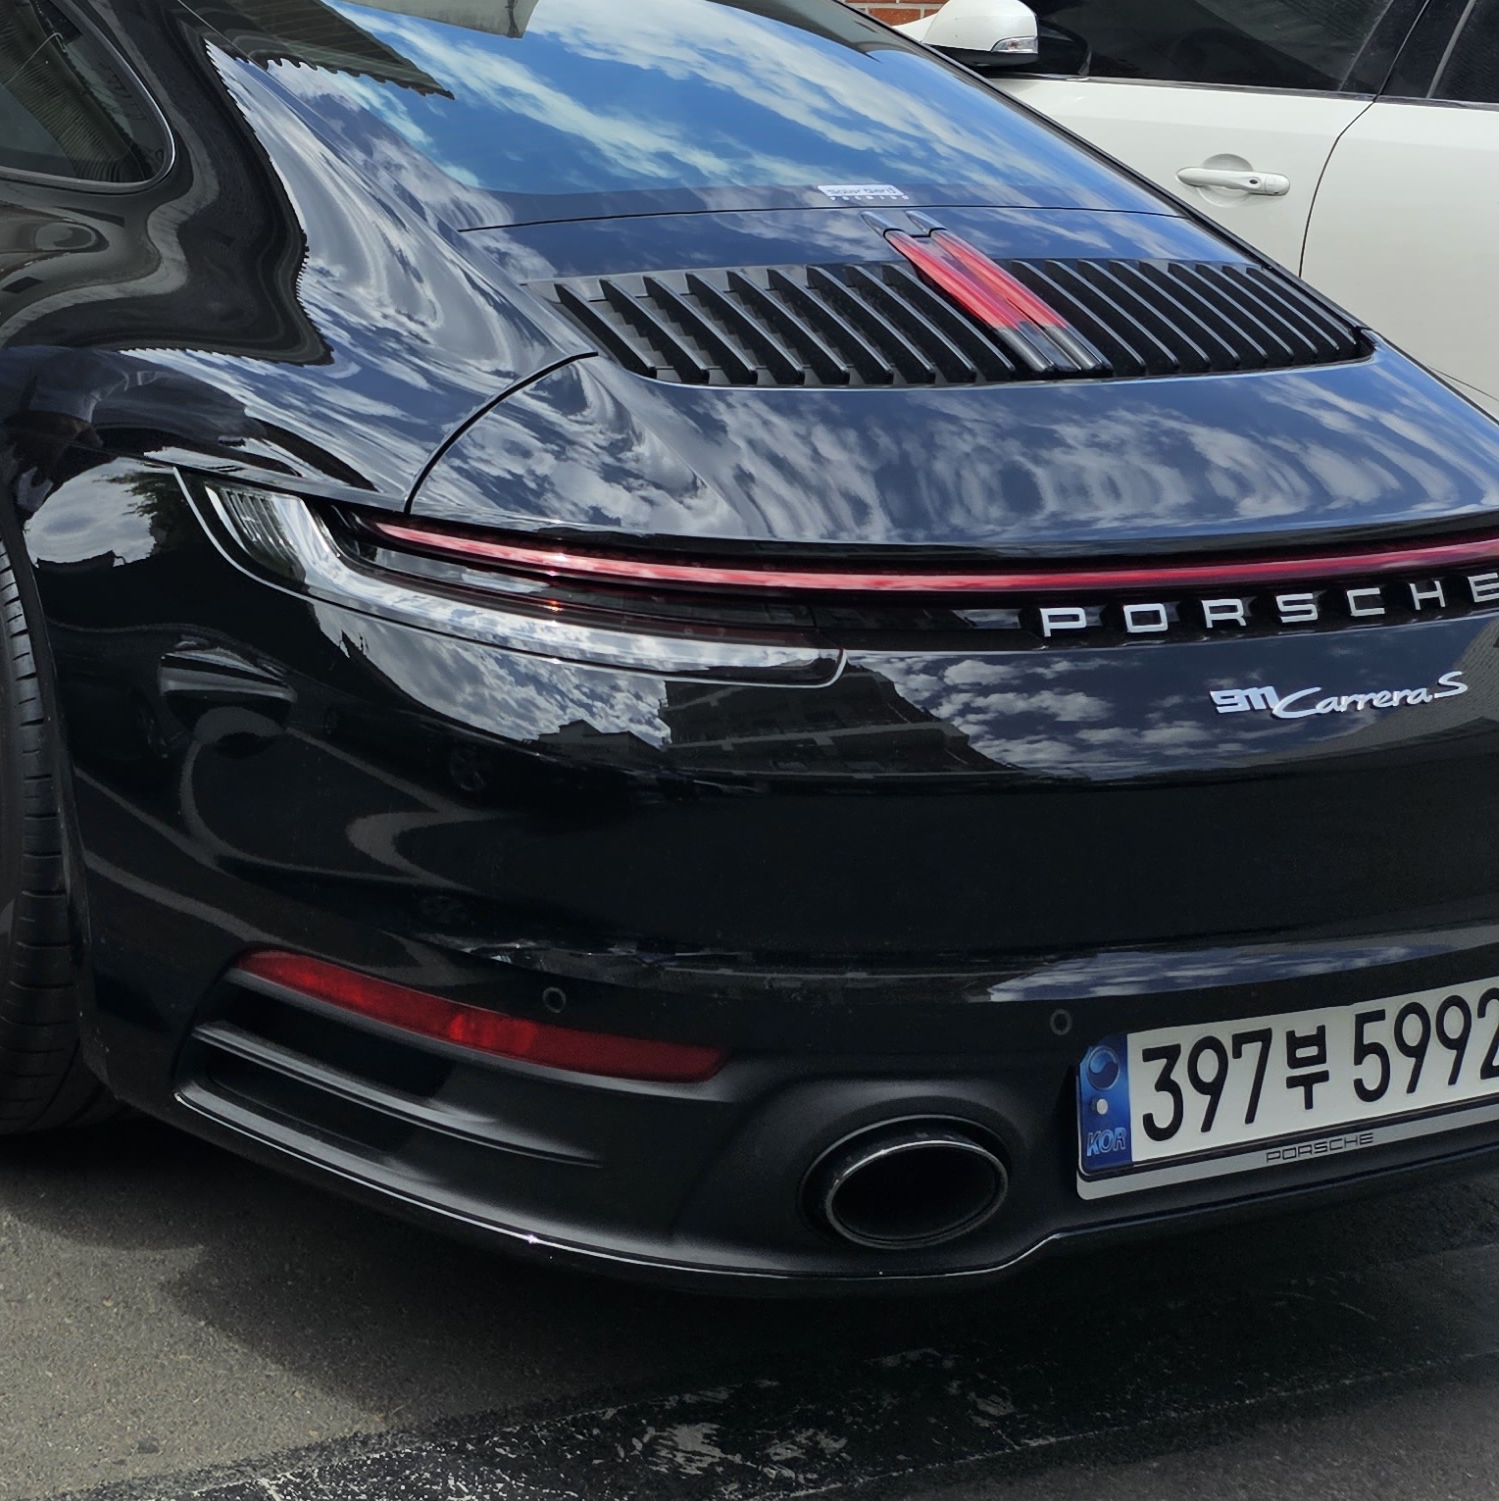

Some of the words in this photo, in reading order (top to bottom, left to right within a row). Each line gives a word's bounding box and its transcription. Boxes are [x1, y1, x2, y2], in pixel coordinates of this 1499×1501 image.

[1040, 572, 1499, 638] PORSCHE
[1210, 686, 1280, 713] 911
[1271, 686, 1434, 719] Carrera
[1434, 671, 1468, 699] S
[1141, 1024, 1330, 1142] 397부
[1353, 987, 1499, 1103] 5992
[1086, 1127, 1127, 1157] KOR
[1265, 1132, 1374, 1164] PORSCHE
